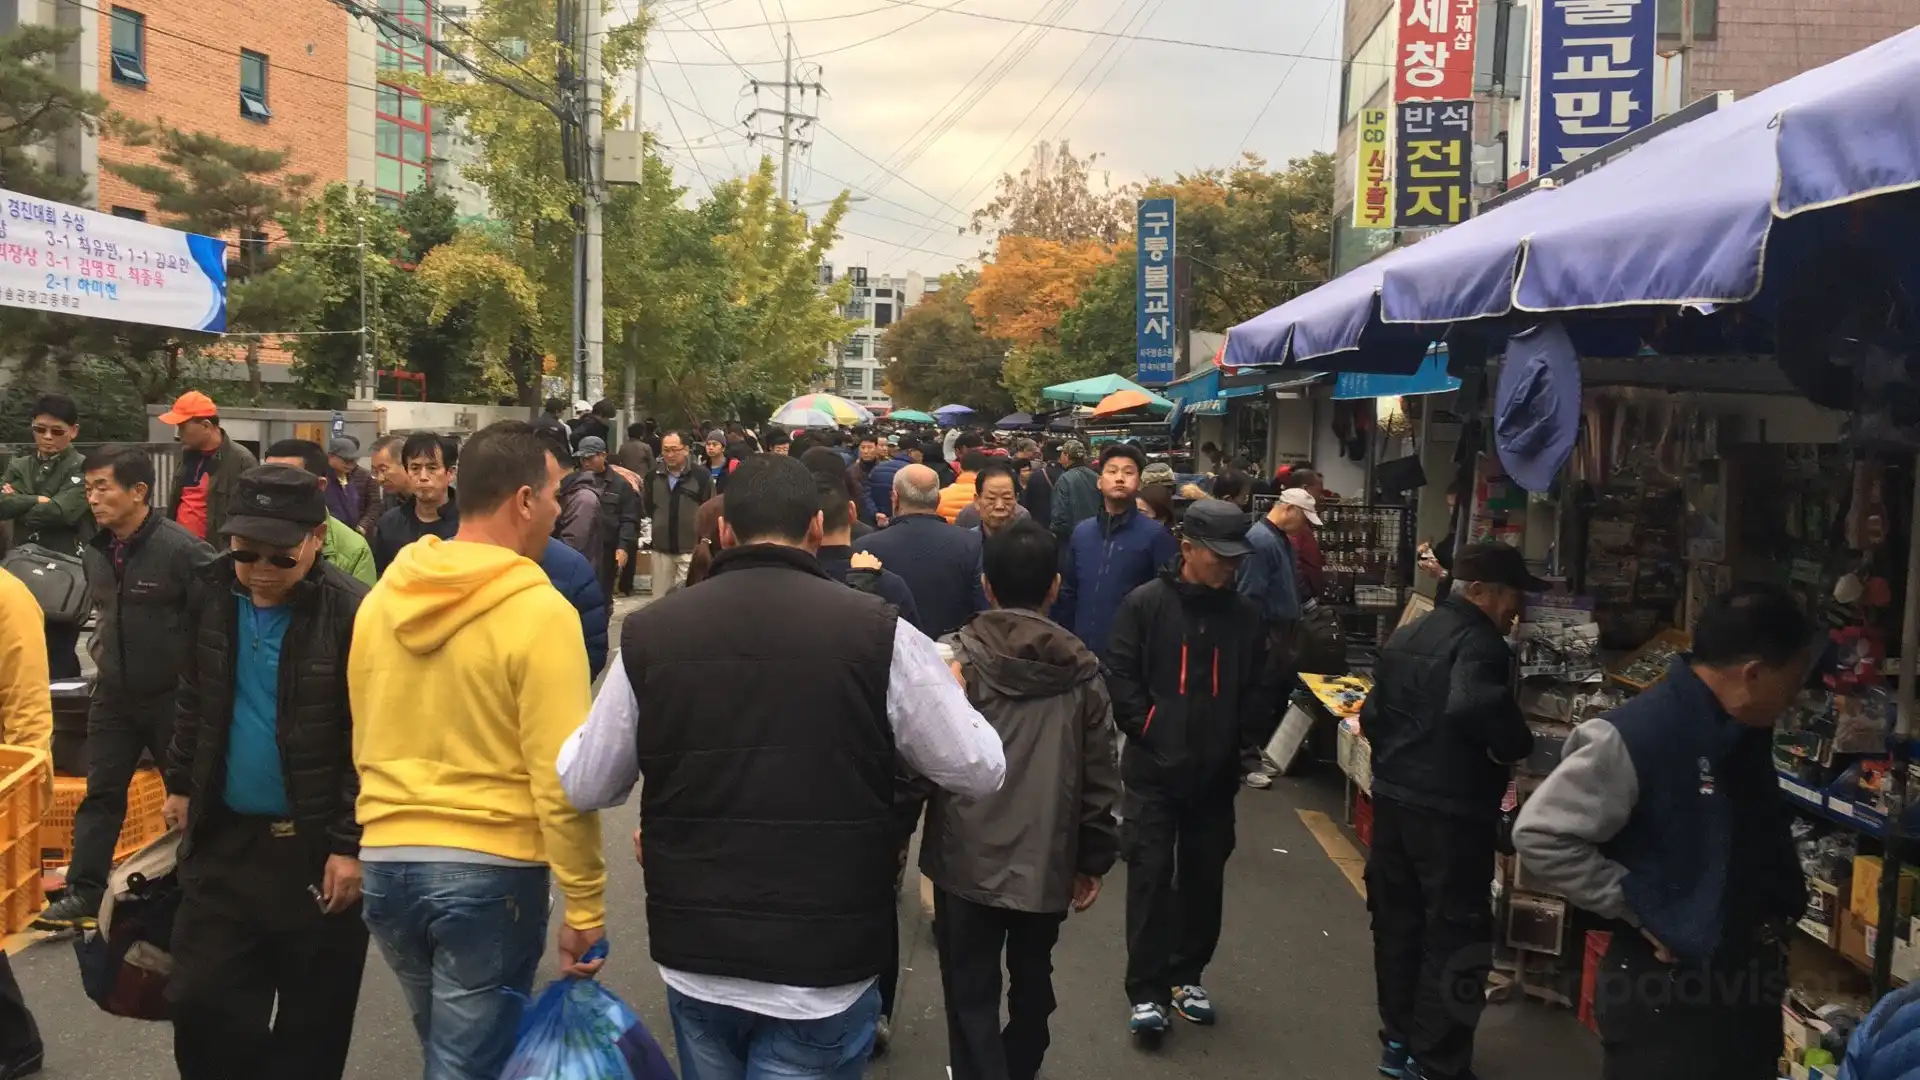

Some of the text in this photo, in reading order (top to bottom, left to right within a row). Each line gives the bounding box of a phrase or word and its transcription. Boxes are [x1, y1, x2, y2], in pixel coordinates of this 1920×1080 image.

[1366, 111, 1385, 125] LP
[1405, 105, 1468, 133] 반석
[1363, 129, 1385, 143] CD
[1405, 139, 1466, 223] 전자
[8, 199, 85, 232] 경진대회 수상
[45, 229, 70, 249] 3-1
[45, 251, 70, 270] 3-1
[46, 273, 70, 291] 2-1
